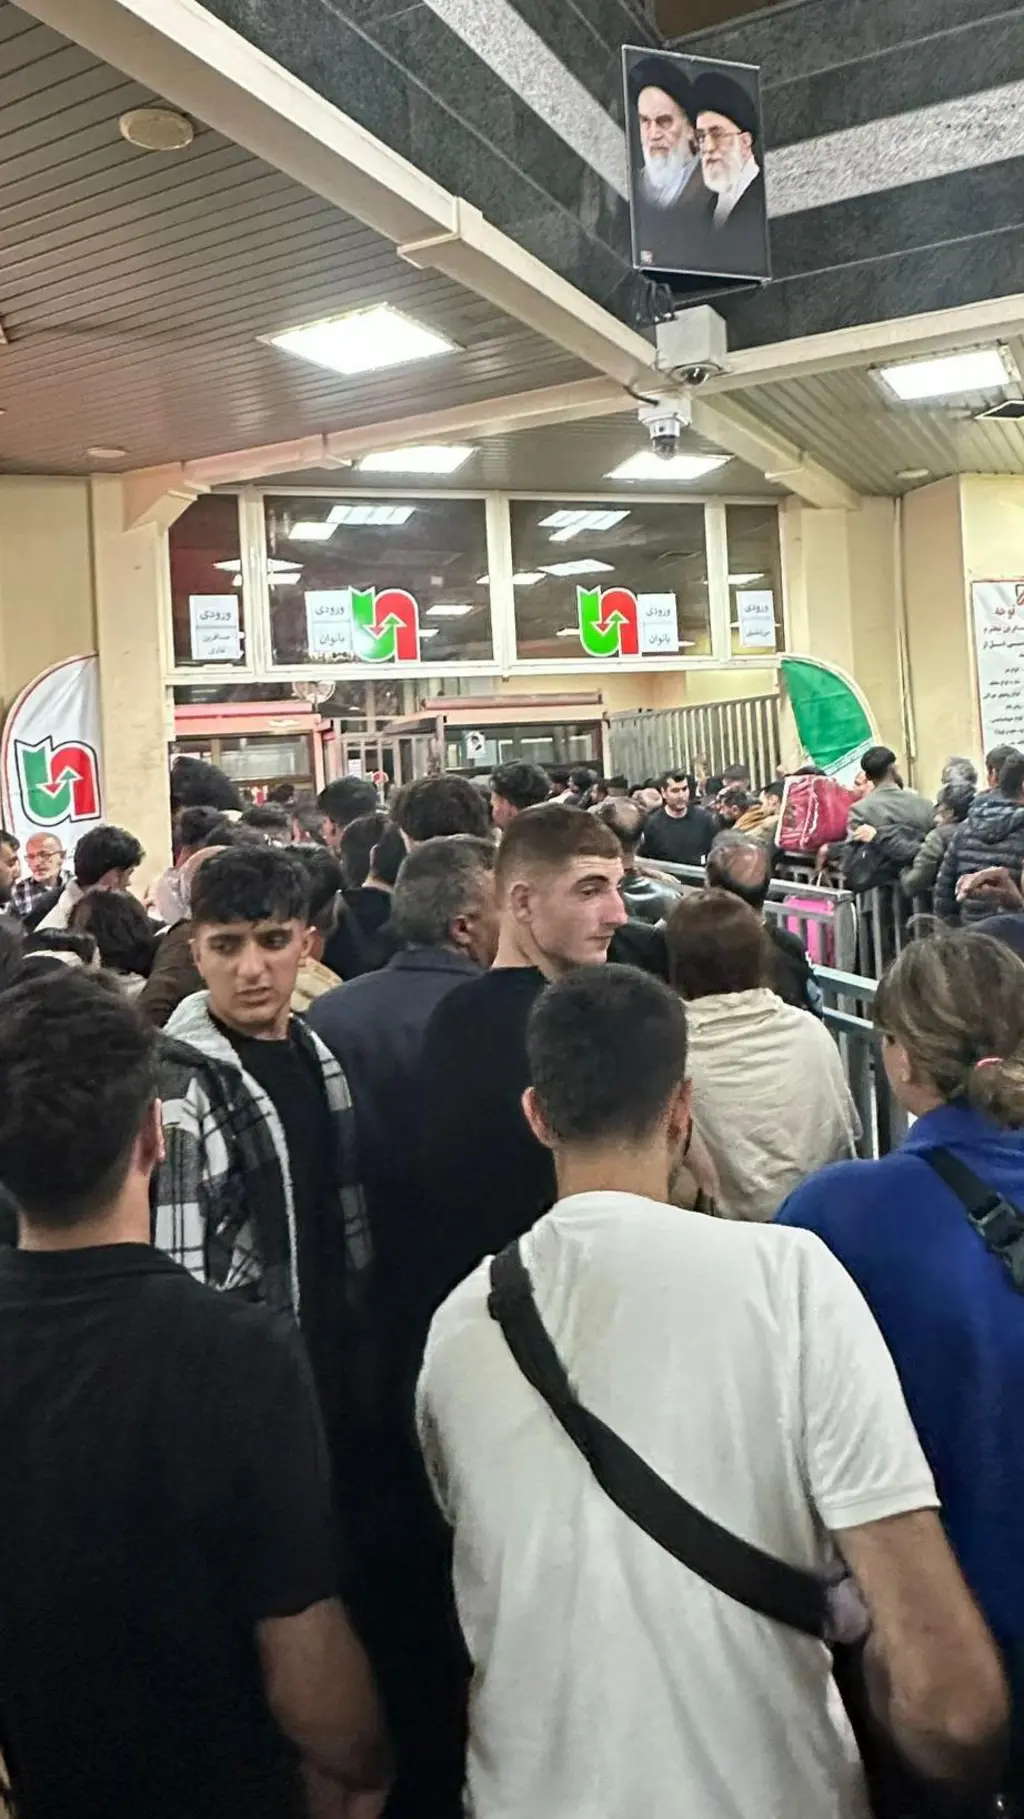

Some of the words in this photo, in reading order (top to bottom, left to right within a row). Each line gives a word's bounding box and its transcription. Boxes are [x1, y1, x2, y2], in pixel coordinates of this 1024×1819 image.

[315, 605, 345, 616] ورودی
[645, 606, 671, 617] ورودی
[744, 603, 769, 613] ورودی
[199, 609, 231, 621] ورودی
[319, 631, 345, 646] بانوان
[648, 633, 671, 646] بانوان
